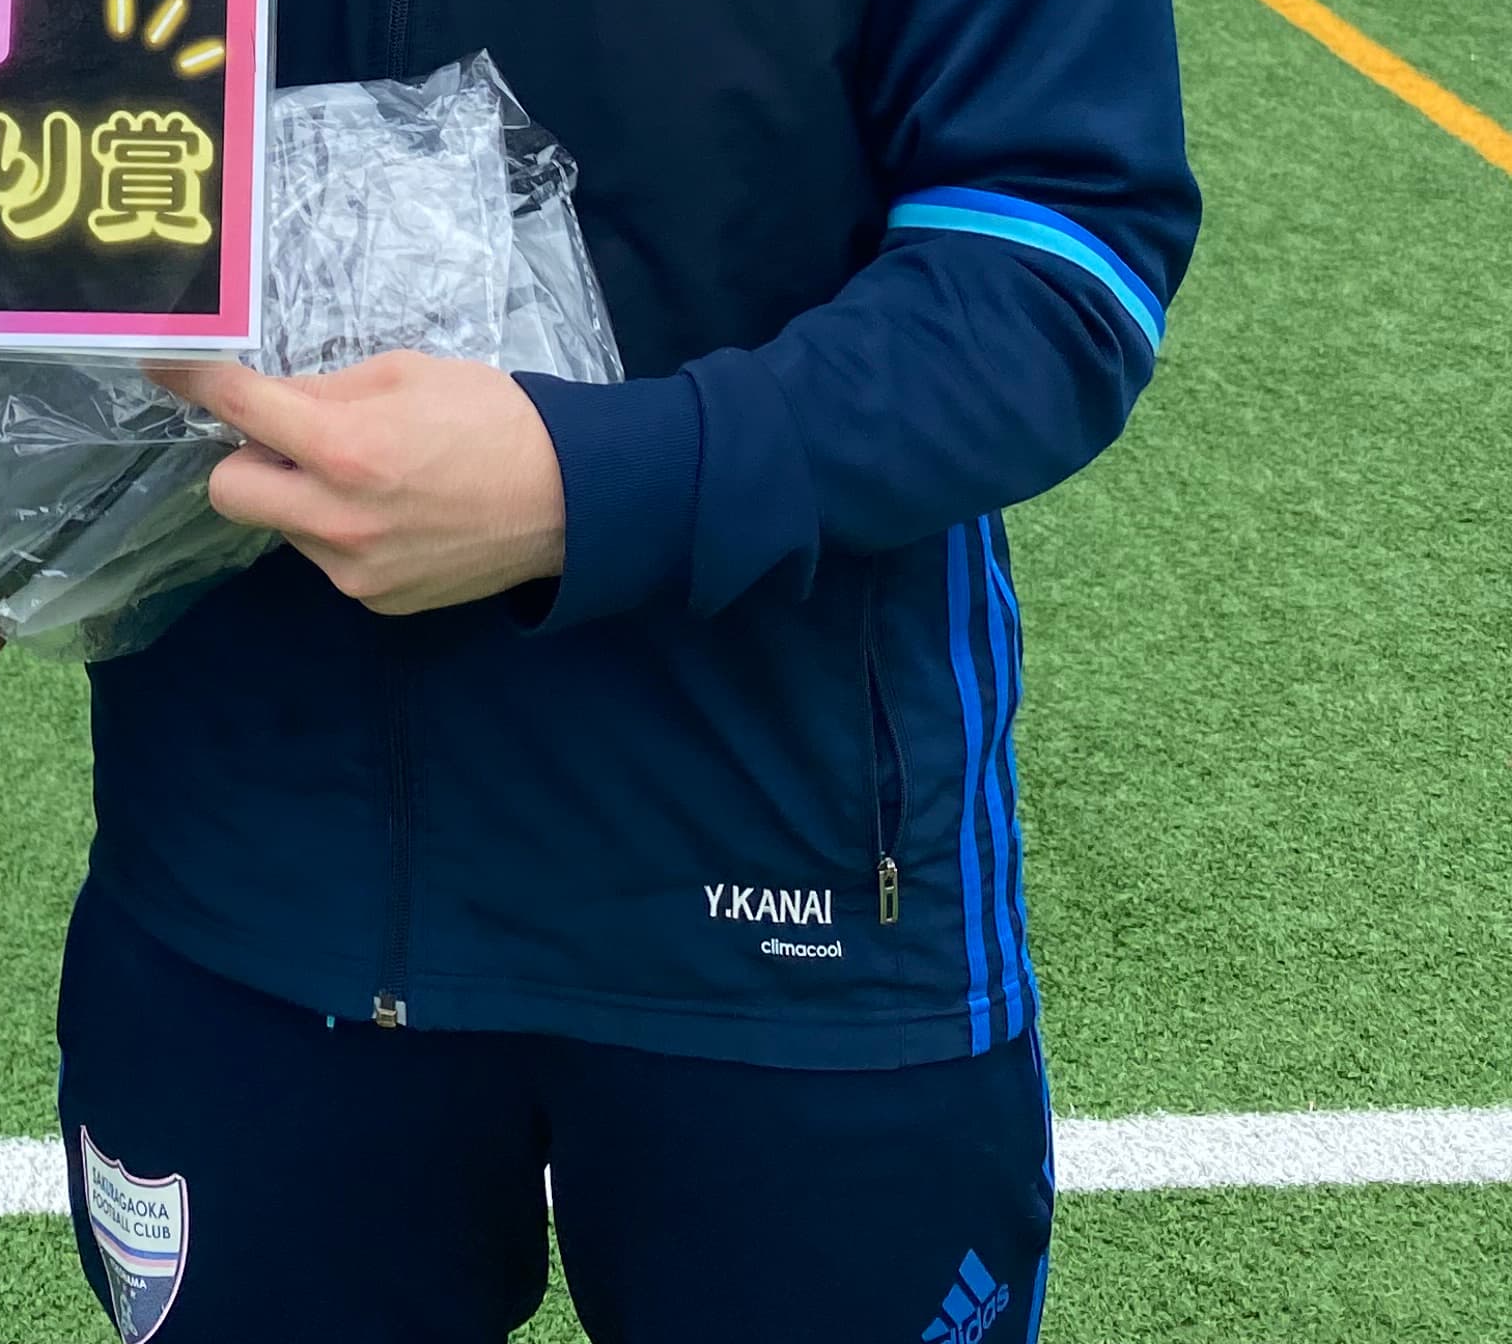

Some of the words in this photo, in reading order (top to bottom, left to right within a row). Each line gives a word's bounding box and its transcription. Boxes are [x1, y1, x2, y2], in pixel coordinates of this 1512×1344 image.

[704, 883, 833, 925] Y.KANAI
[760, 938, 843, 958] climacool
[133, 1221, 172, 1240] CLUB
